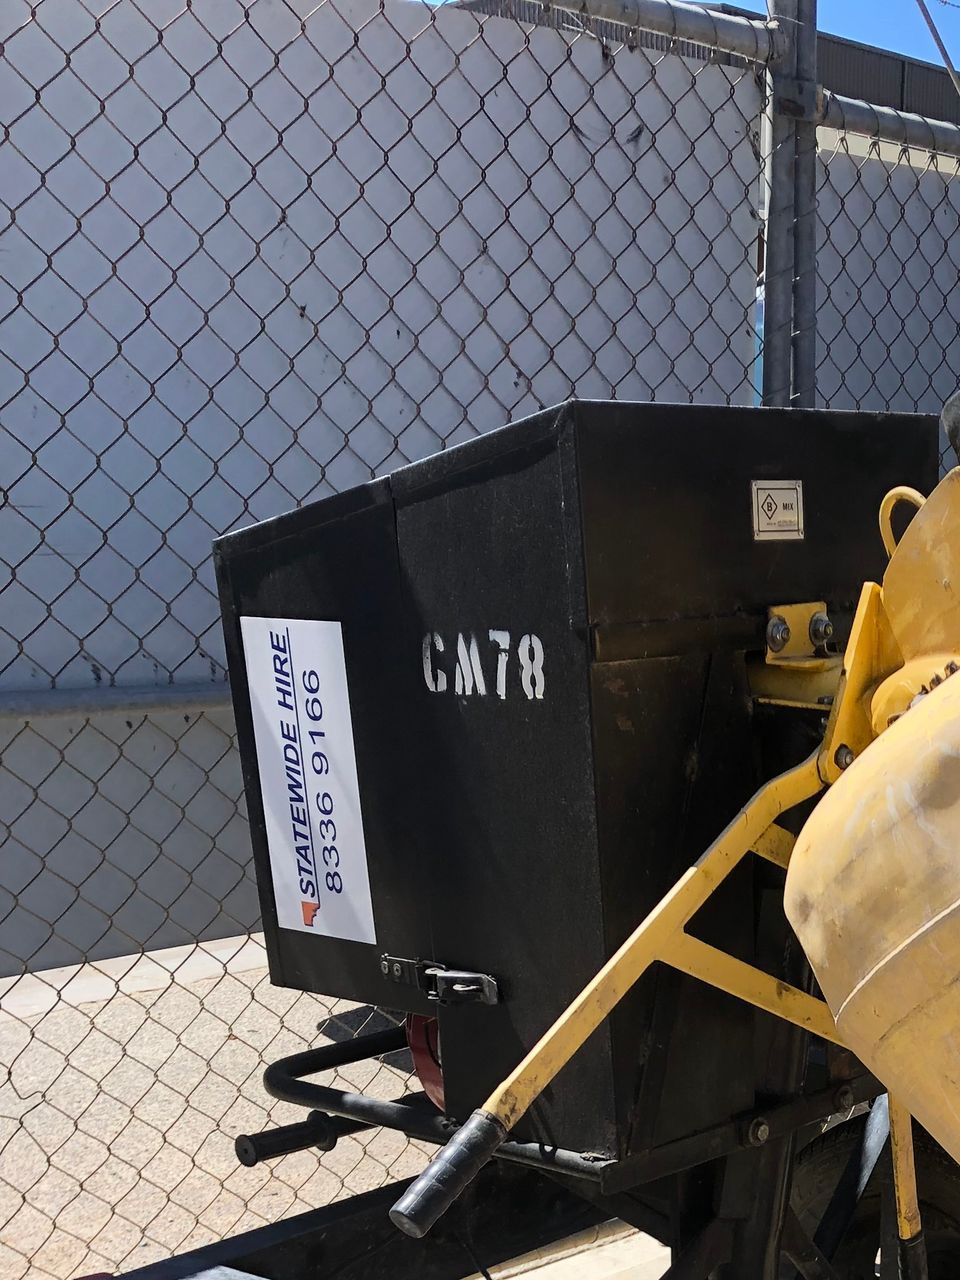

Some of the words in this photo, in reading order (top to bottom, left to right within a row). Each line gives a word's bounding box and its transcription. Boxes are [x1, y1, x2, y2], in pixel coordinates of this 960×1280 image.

[766, 502, 773, 511] B
[782, 502, 794, 511] MIX
[270, 630, 295, 711] HIRE
[422, 629, 545, 699] CM78
[303, 670, 329, 775] 9166
[280, 720, 316, 898] STATEWIDE
[316, 792, 343, 894] 8336
